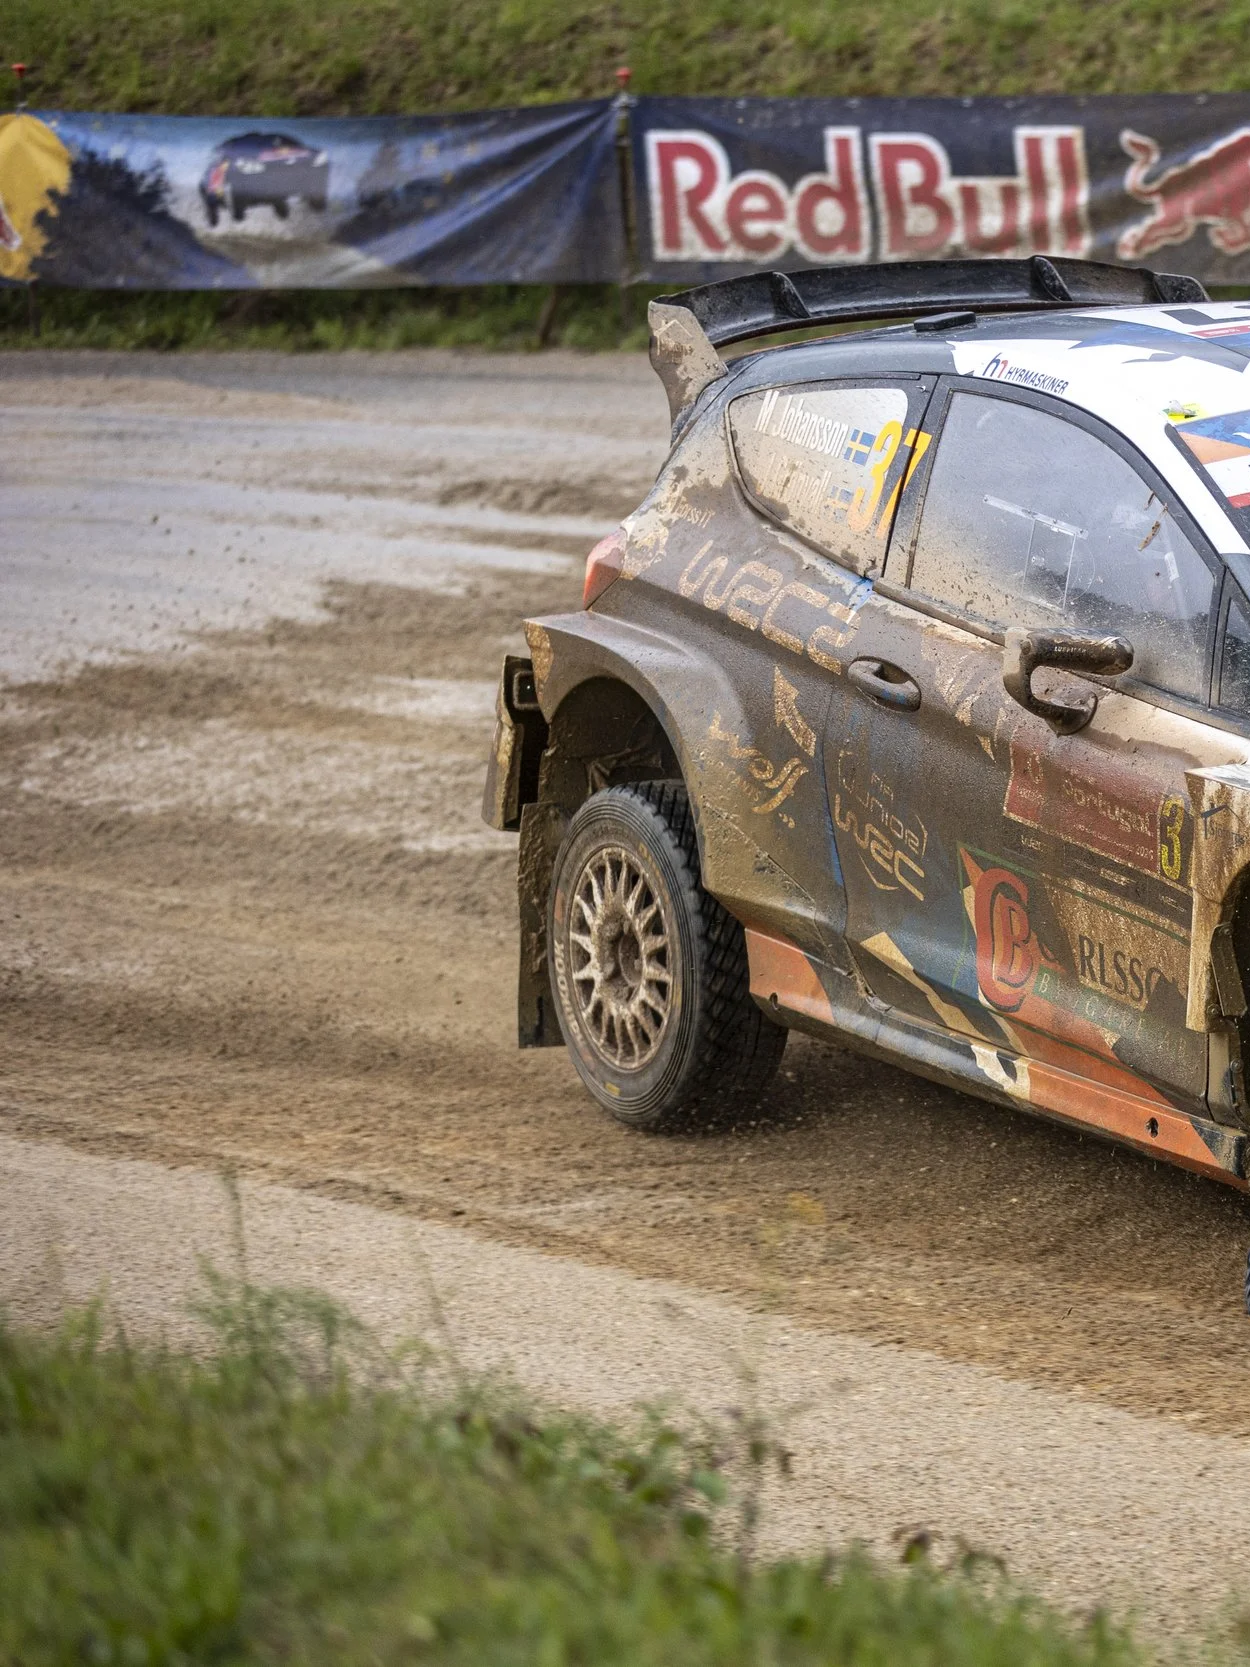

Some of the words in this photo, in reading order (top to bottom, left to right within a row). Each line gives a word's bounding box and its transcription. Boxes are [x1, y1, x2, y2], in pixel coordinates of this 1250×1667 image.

[648, 128, 866, 260] Red
[871, 126, 1088, 258] Bull
[755, 390, 779, 433] M
[772, 395, 848, 458] Johansson
[1005, 366, 1069, 395] HYRMASKINER
[848, 420, 932, 540] 37
[678, 539, 862, 676] WRC2
[834, 793, 925, 902] WRC
[1161, 799, 1184, 880] 3
